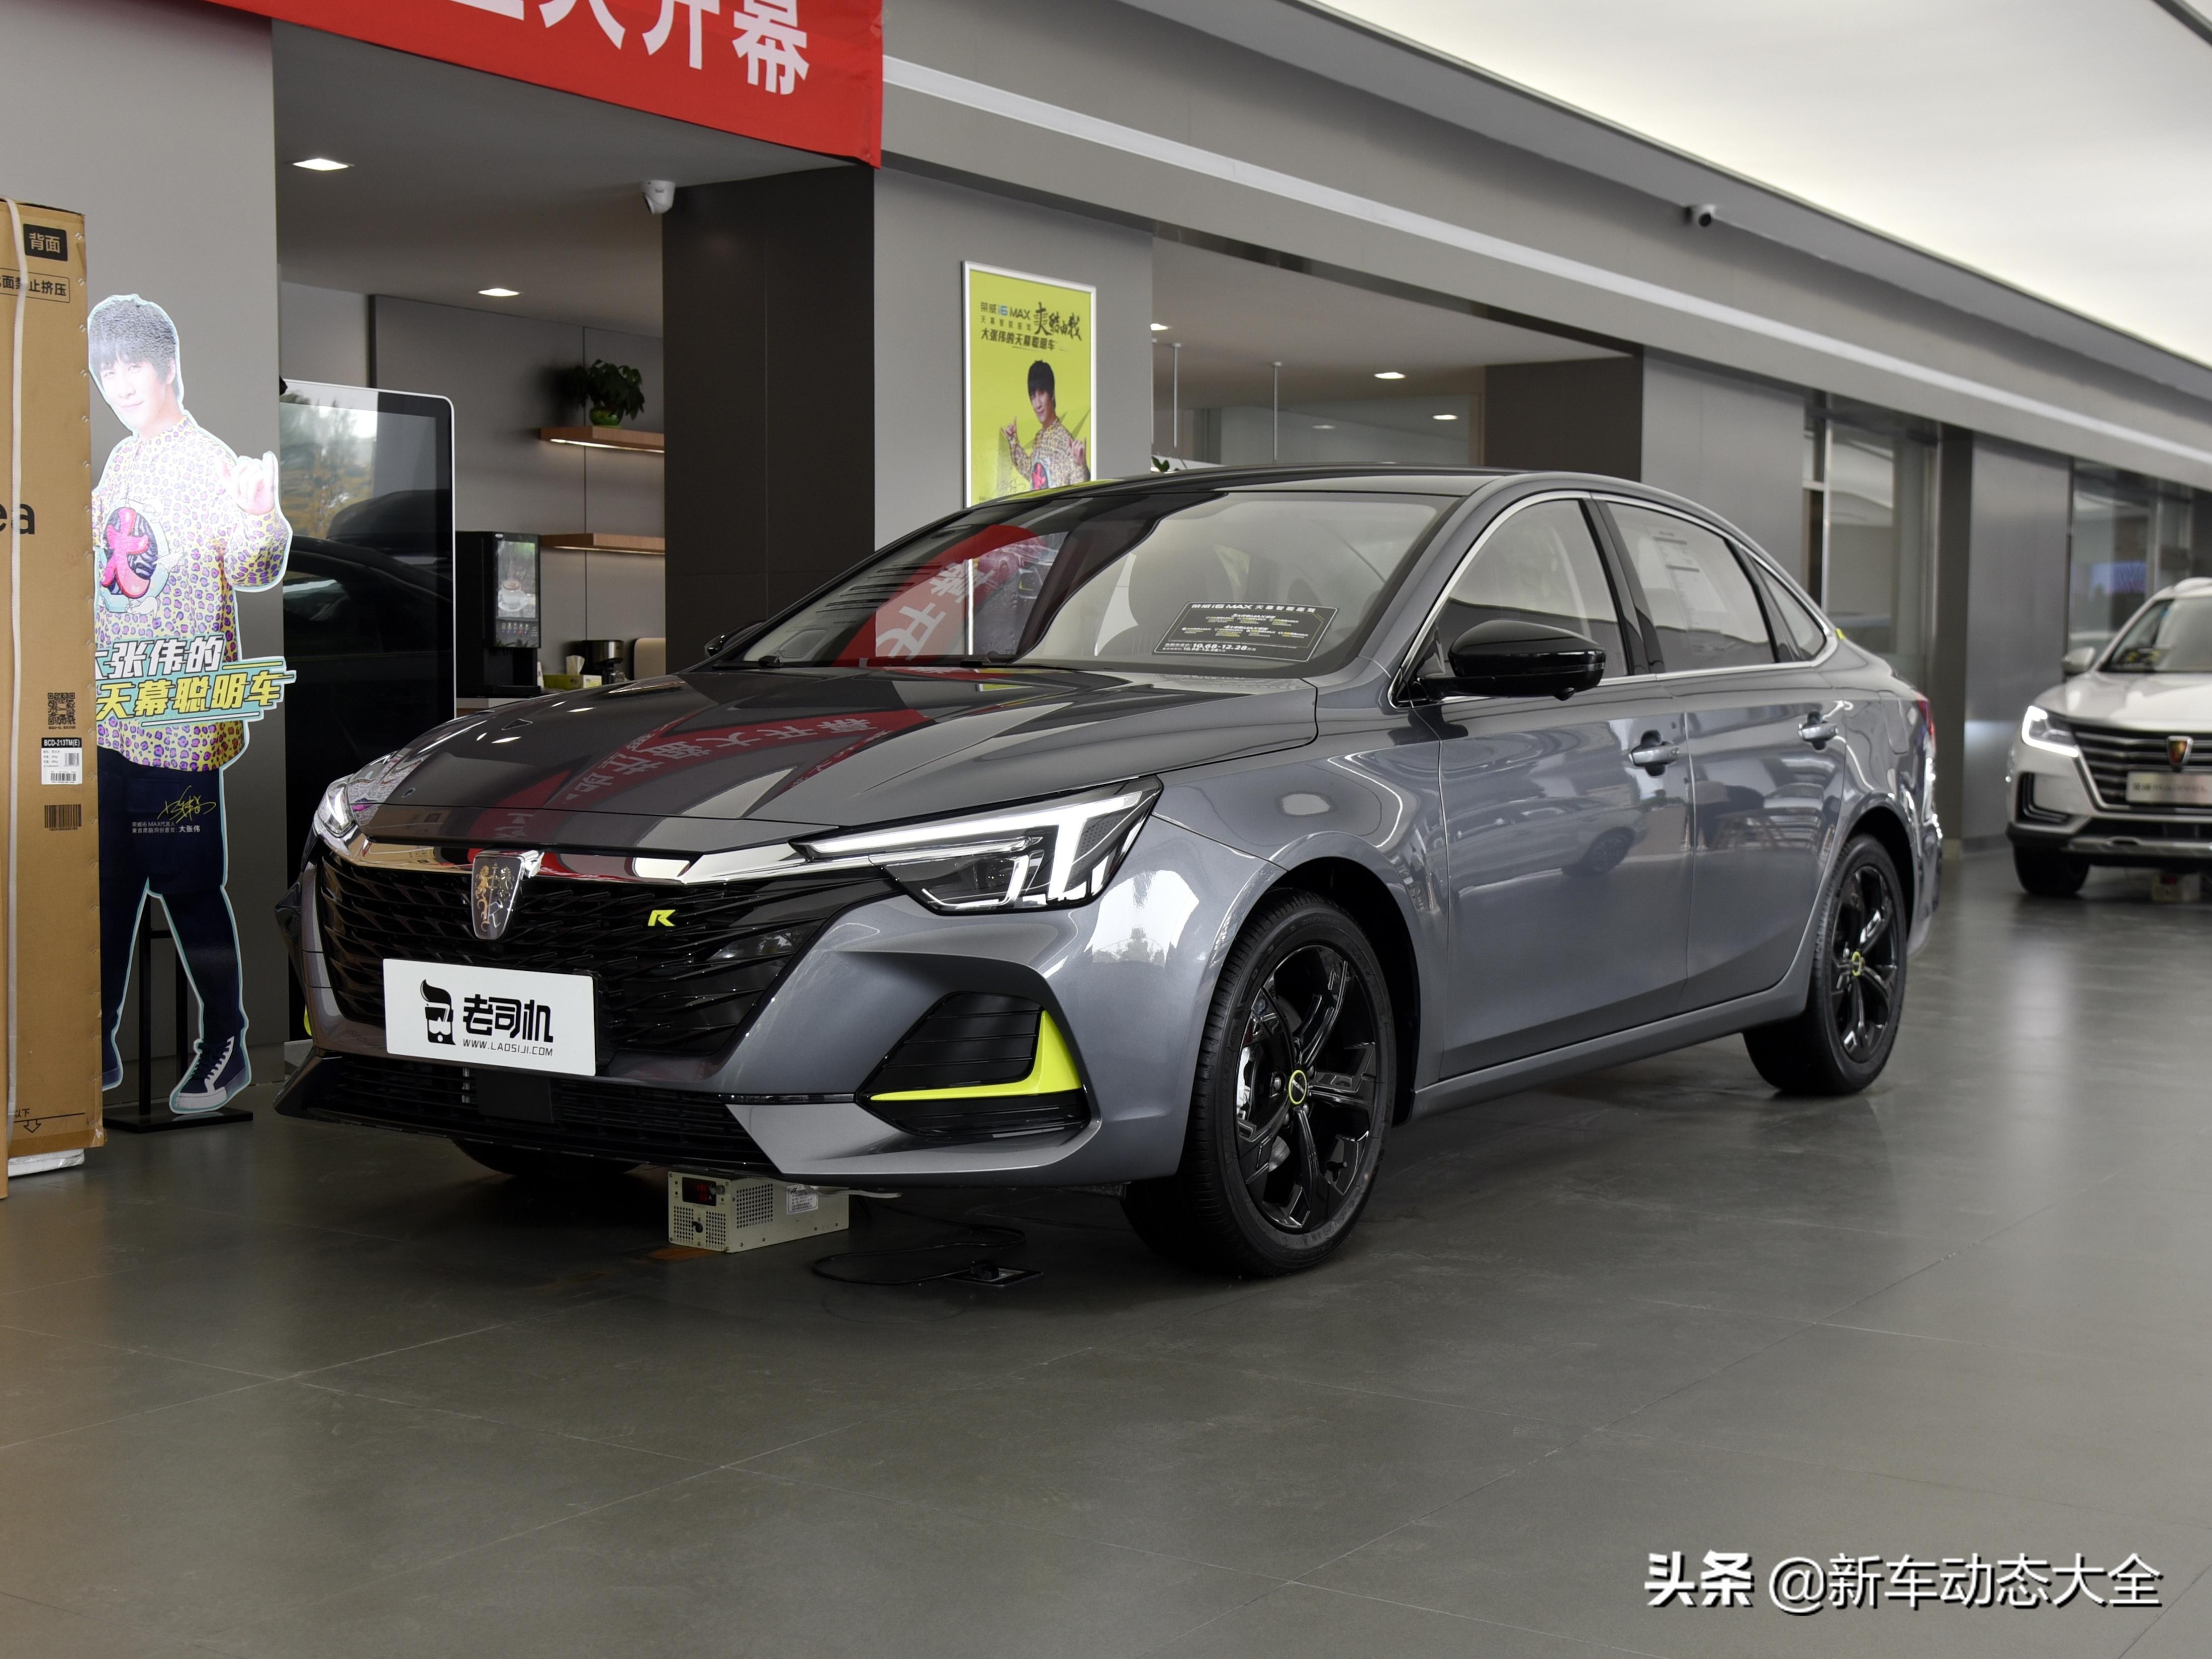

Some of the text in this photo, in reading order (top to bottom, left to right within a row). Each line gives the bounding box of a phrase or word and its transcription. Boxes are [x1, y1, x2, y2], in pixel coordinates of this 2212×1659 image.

[29, 232, 60, 254] 背面
[1009, 306, 1031, 320] MAX
[981, 328, 1057, 351] 大张伟的天幕聪明车
[96, 670, 294, 721] 天幕聪明车
[44, 739, 80, 747] BCD-213TM(E)
[179, 825, 201, 833] 大张伟
[463, 994, 554, 1043] 老司机
[463, 1038, 554, 1056] WWW.LAOSIJI.COM
